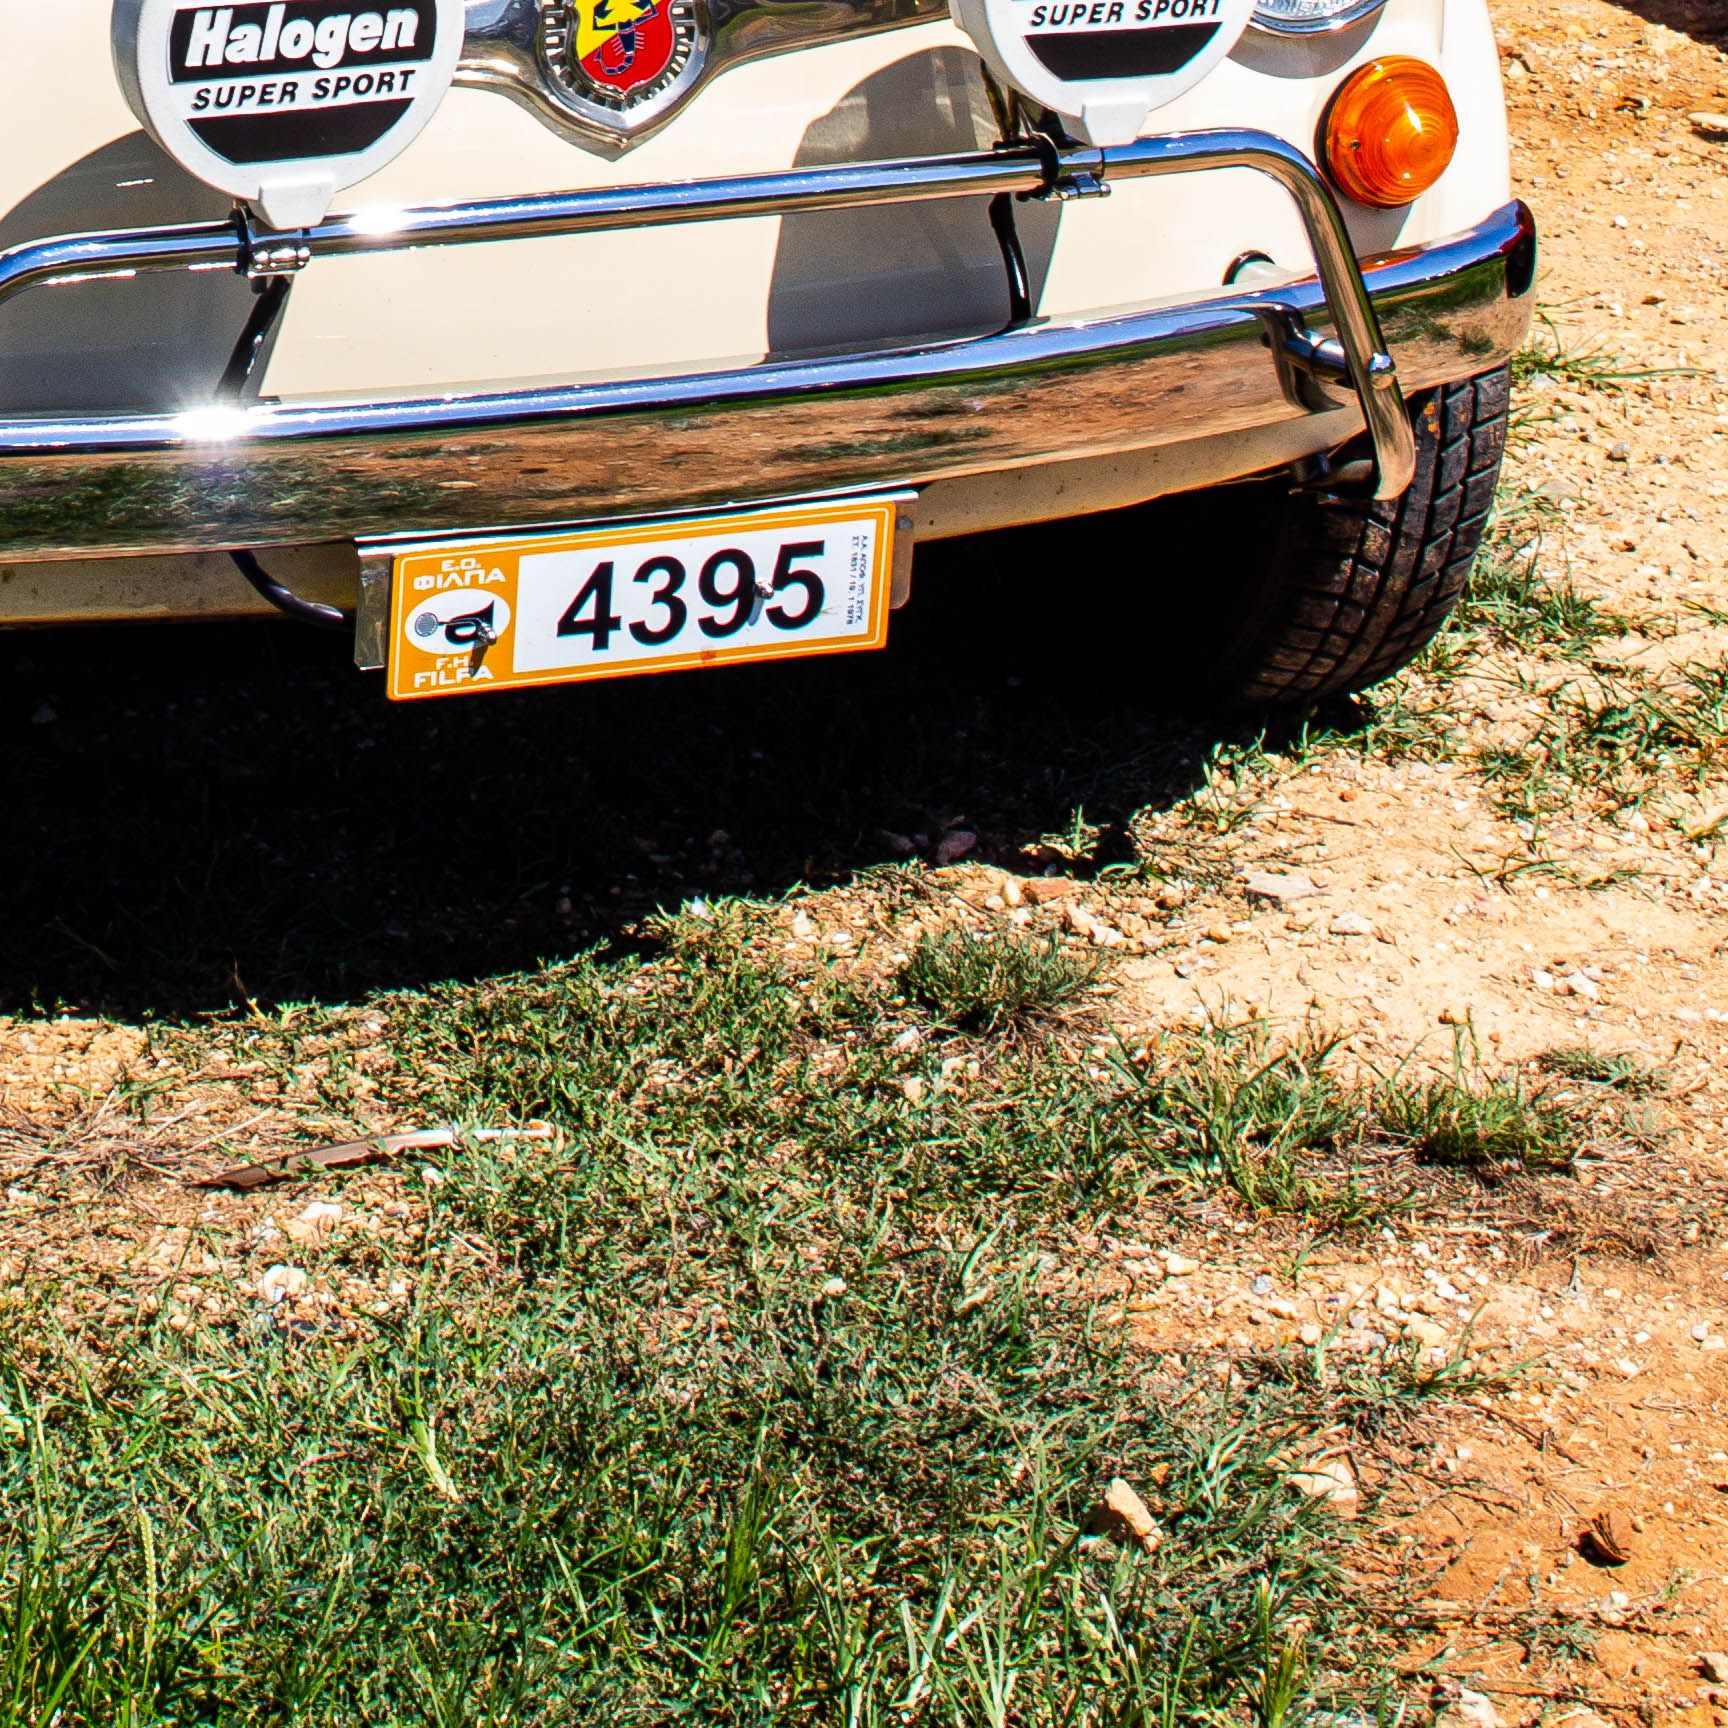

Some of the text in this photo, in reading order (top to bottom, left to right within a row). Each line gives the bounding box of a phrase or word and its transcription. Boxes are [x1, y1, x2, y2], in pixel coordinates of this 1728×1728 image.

[1029, 2, 1123, 27] SUPER
[184, 2, 420, 69] Halogen
[191, 69, 417, 110] SUPER SPORT
[412, 567, 507, 591] ΦΙΛΠΑ
[556, 539, 827, 652] 4395
